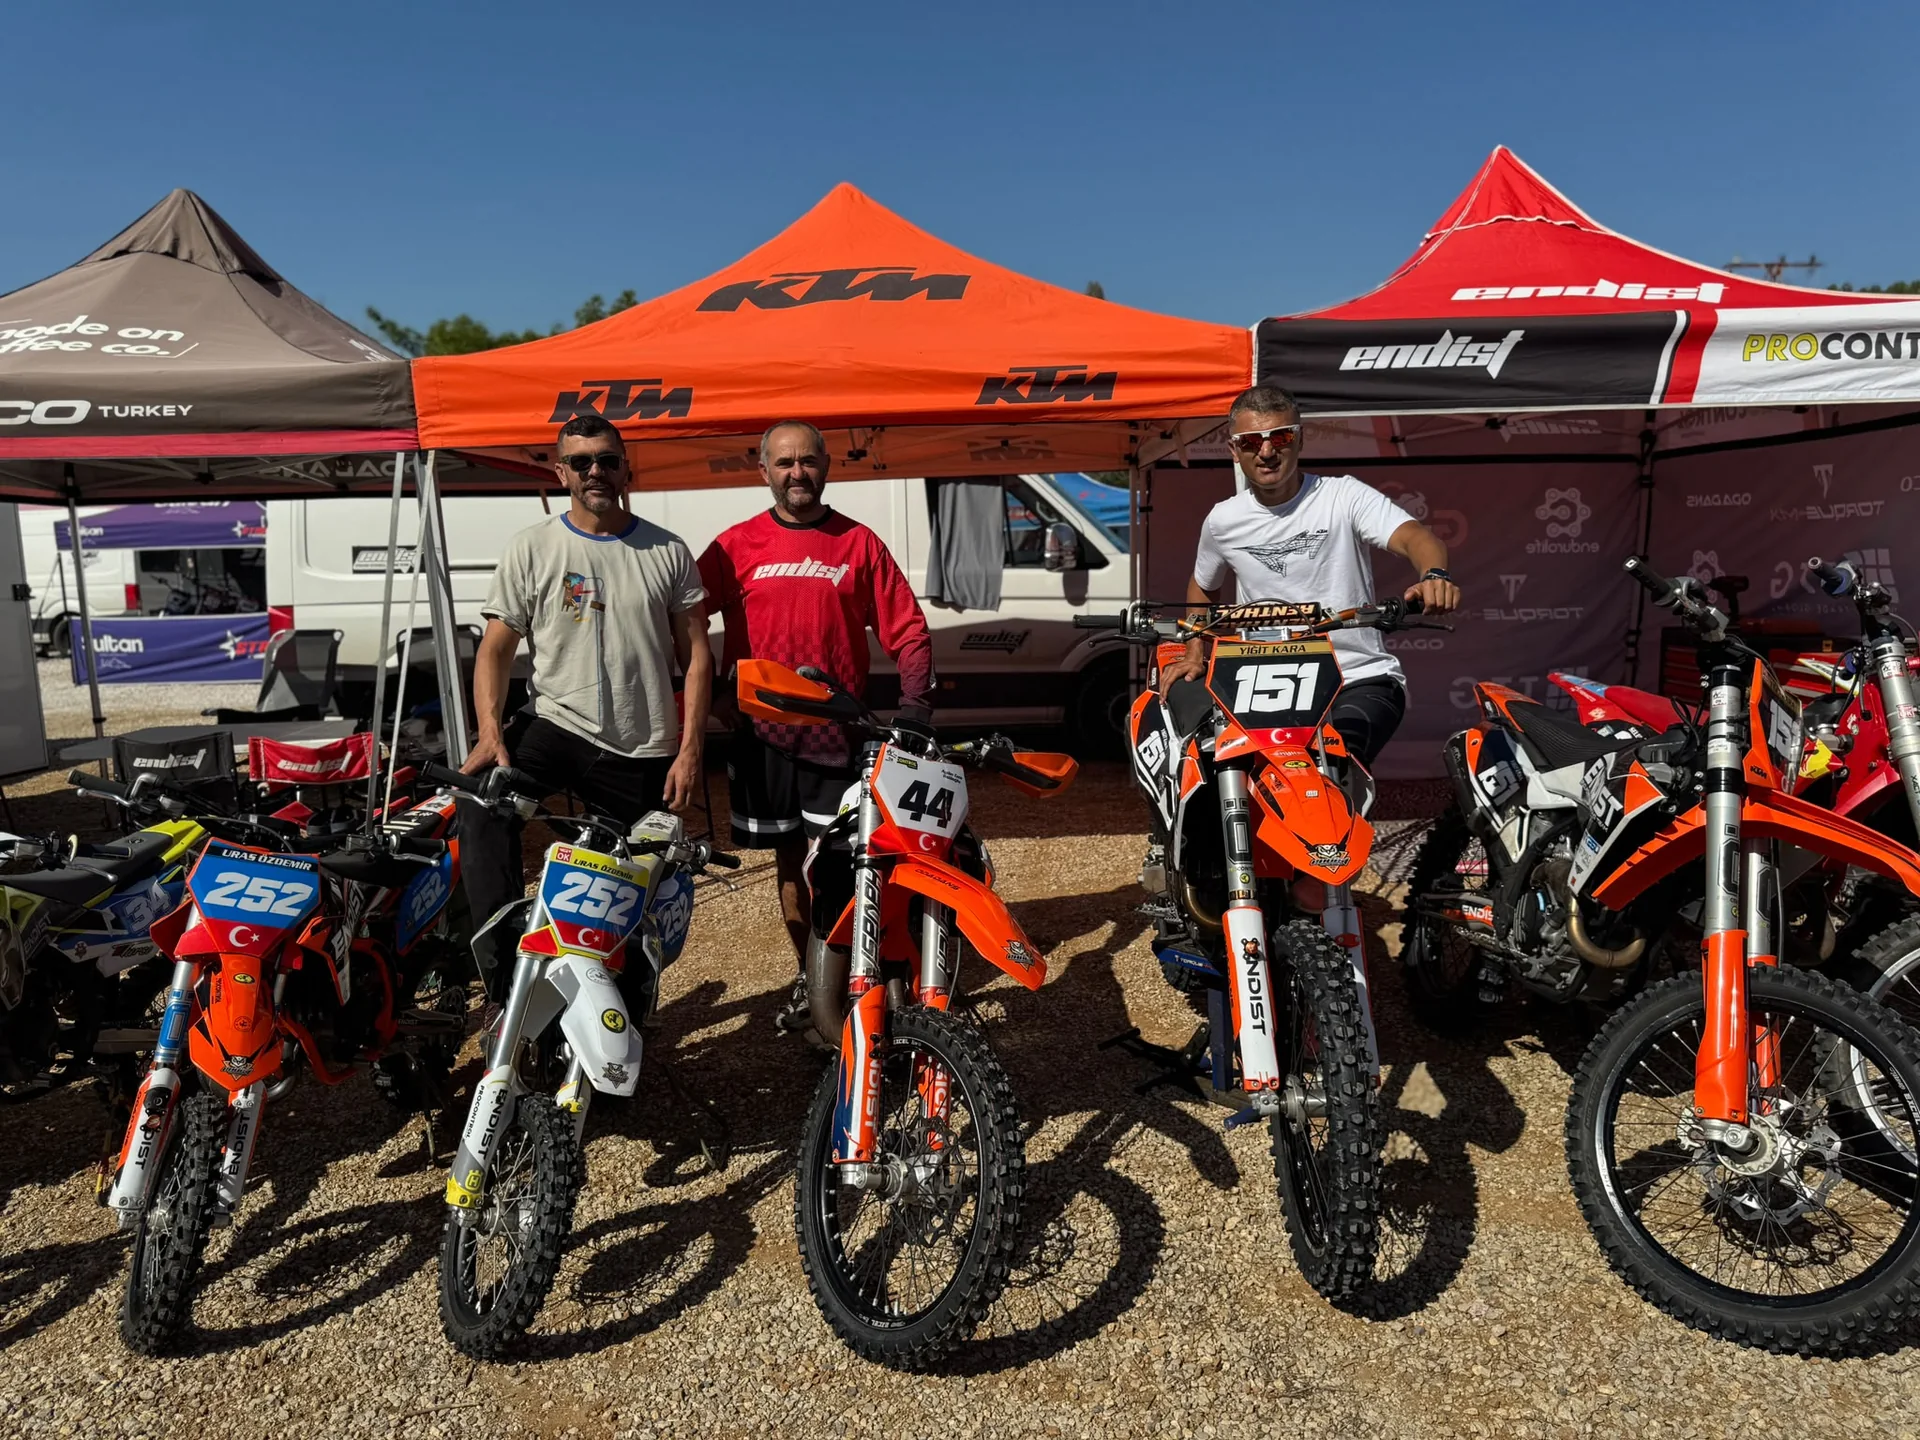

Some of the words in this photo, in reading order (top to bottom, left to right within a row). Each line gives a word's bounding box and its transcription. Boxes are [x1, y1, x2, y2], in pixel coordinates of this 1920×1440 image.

[695, 266, 972, 312] KTM
[0, 315, 110, 340] ode
[117, 327, 185, 342] on
[0, 336, 92, 354] ffee
[101, 343, 170, 354] co.
[1339, 329, 1525, 379] endist
[547, 378, 693, 423] KTM
[975, 365, 1118, 405] KTM
[98, 404, 193, 418] TURKEY
[752, 556, 850, 587] endist
[1215, 601, 1315, 619] RENTHAL
[81, 635, 143, 653] ultan
[1272, 645, 1306, 654] KARA
[1233, 663, 1320, 714] 151
[1750, 765, 1768, 780] KTM
[898, 780, 955, 829] 44
[258, 853, 312, 871] ÖZDEMİR
[557, 851, 570, 861] OK
[600, 865, 634, 881] ÖZDEMİR
[203, 872, 314, 917] 252
[549, 871, 640, 926] 252
[1461, 903, 1494, 922] ENDIS
[1246, 959, 1267, 1036] NDIST
[466, 1084, 486, 1139] PROCONTROL
[478, 1088, 508, 1161] ENDIST
[134, 1130, 155, 1171] DIST
[228, 1113, 251, 1176] ENDIST
